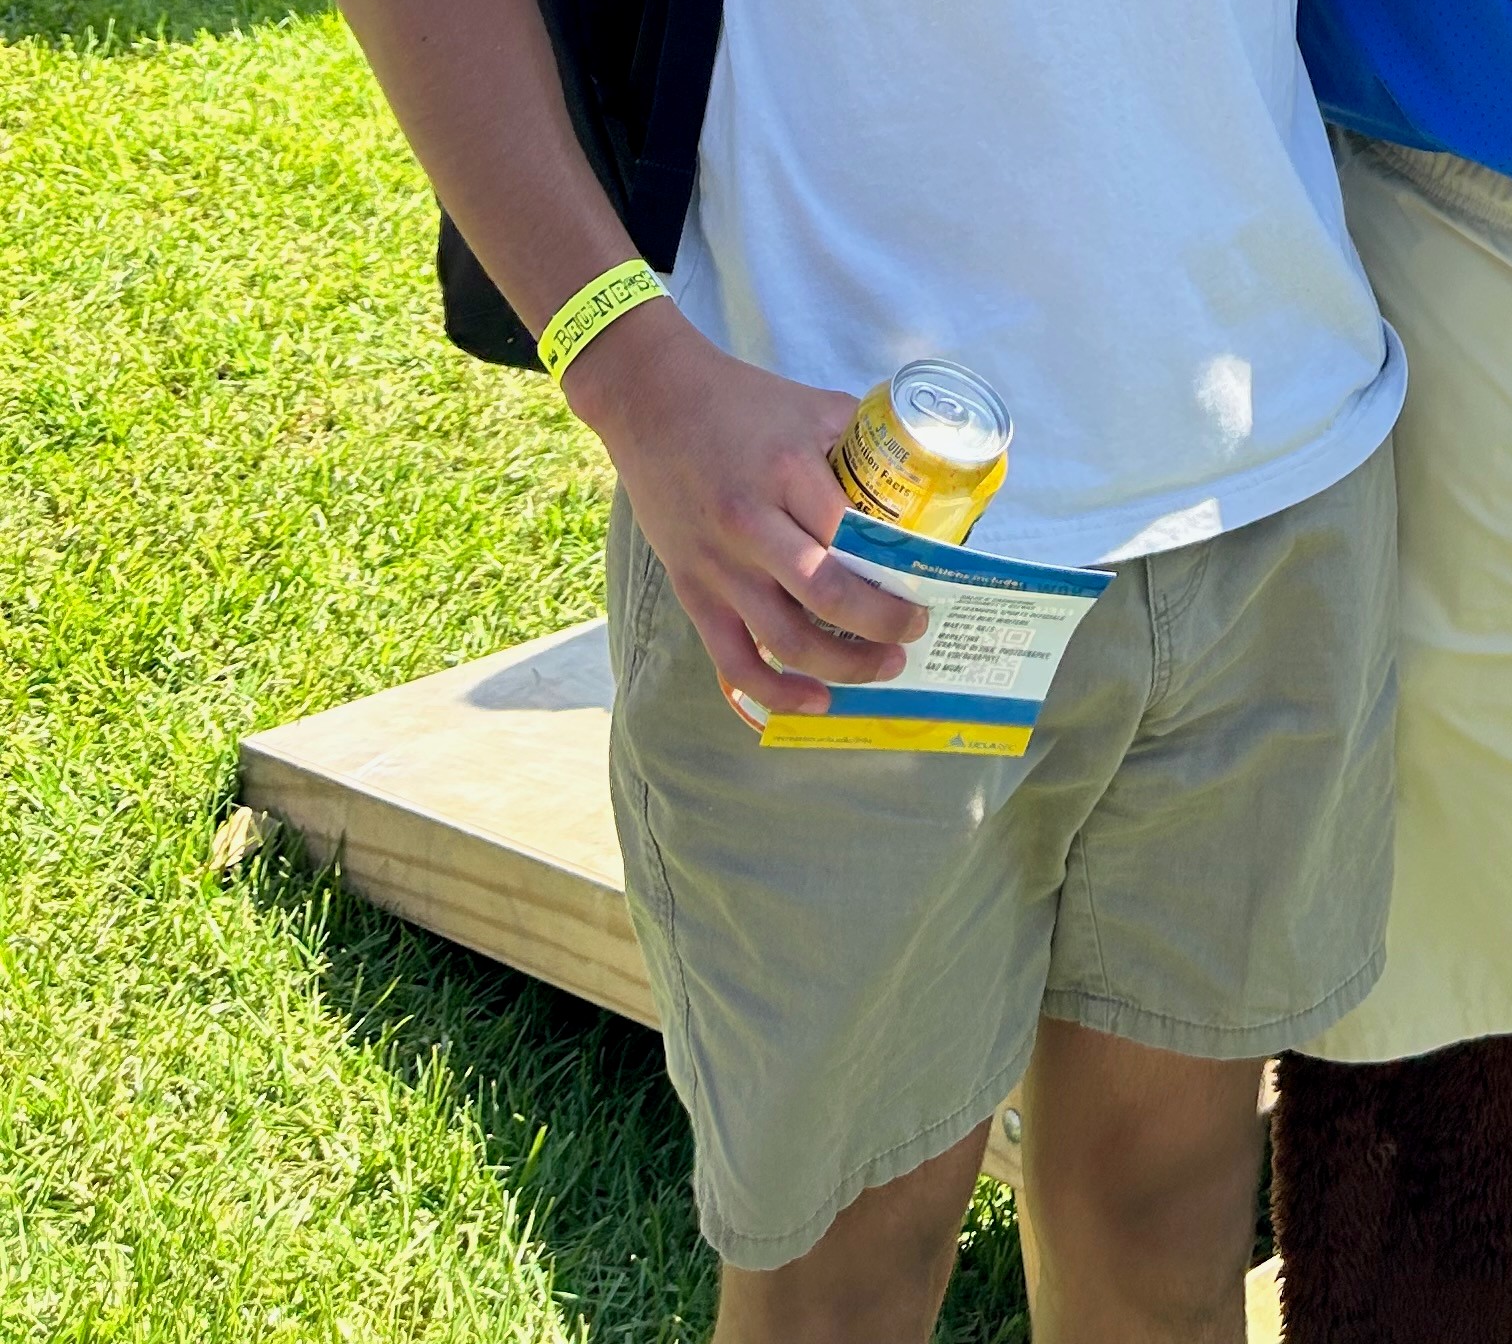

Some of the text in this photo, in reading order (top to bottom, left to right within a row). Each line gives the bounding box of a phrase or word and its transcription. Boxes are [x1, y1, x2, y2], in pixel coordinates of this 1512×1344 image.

[853, 422, 880, 472] Nutrition
[880, 469, 912, 498] Facts
[883, 437, 911, 464] JUICE
